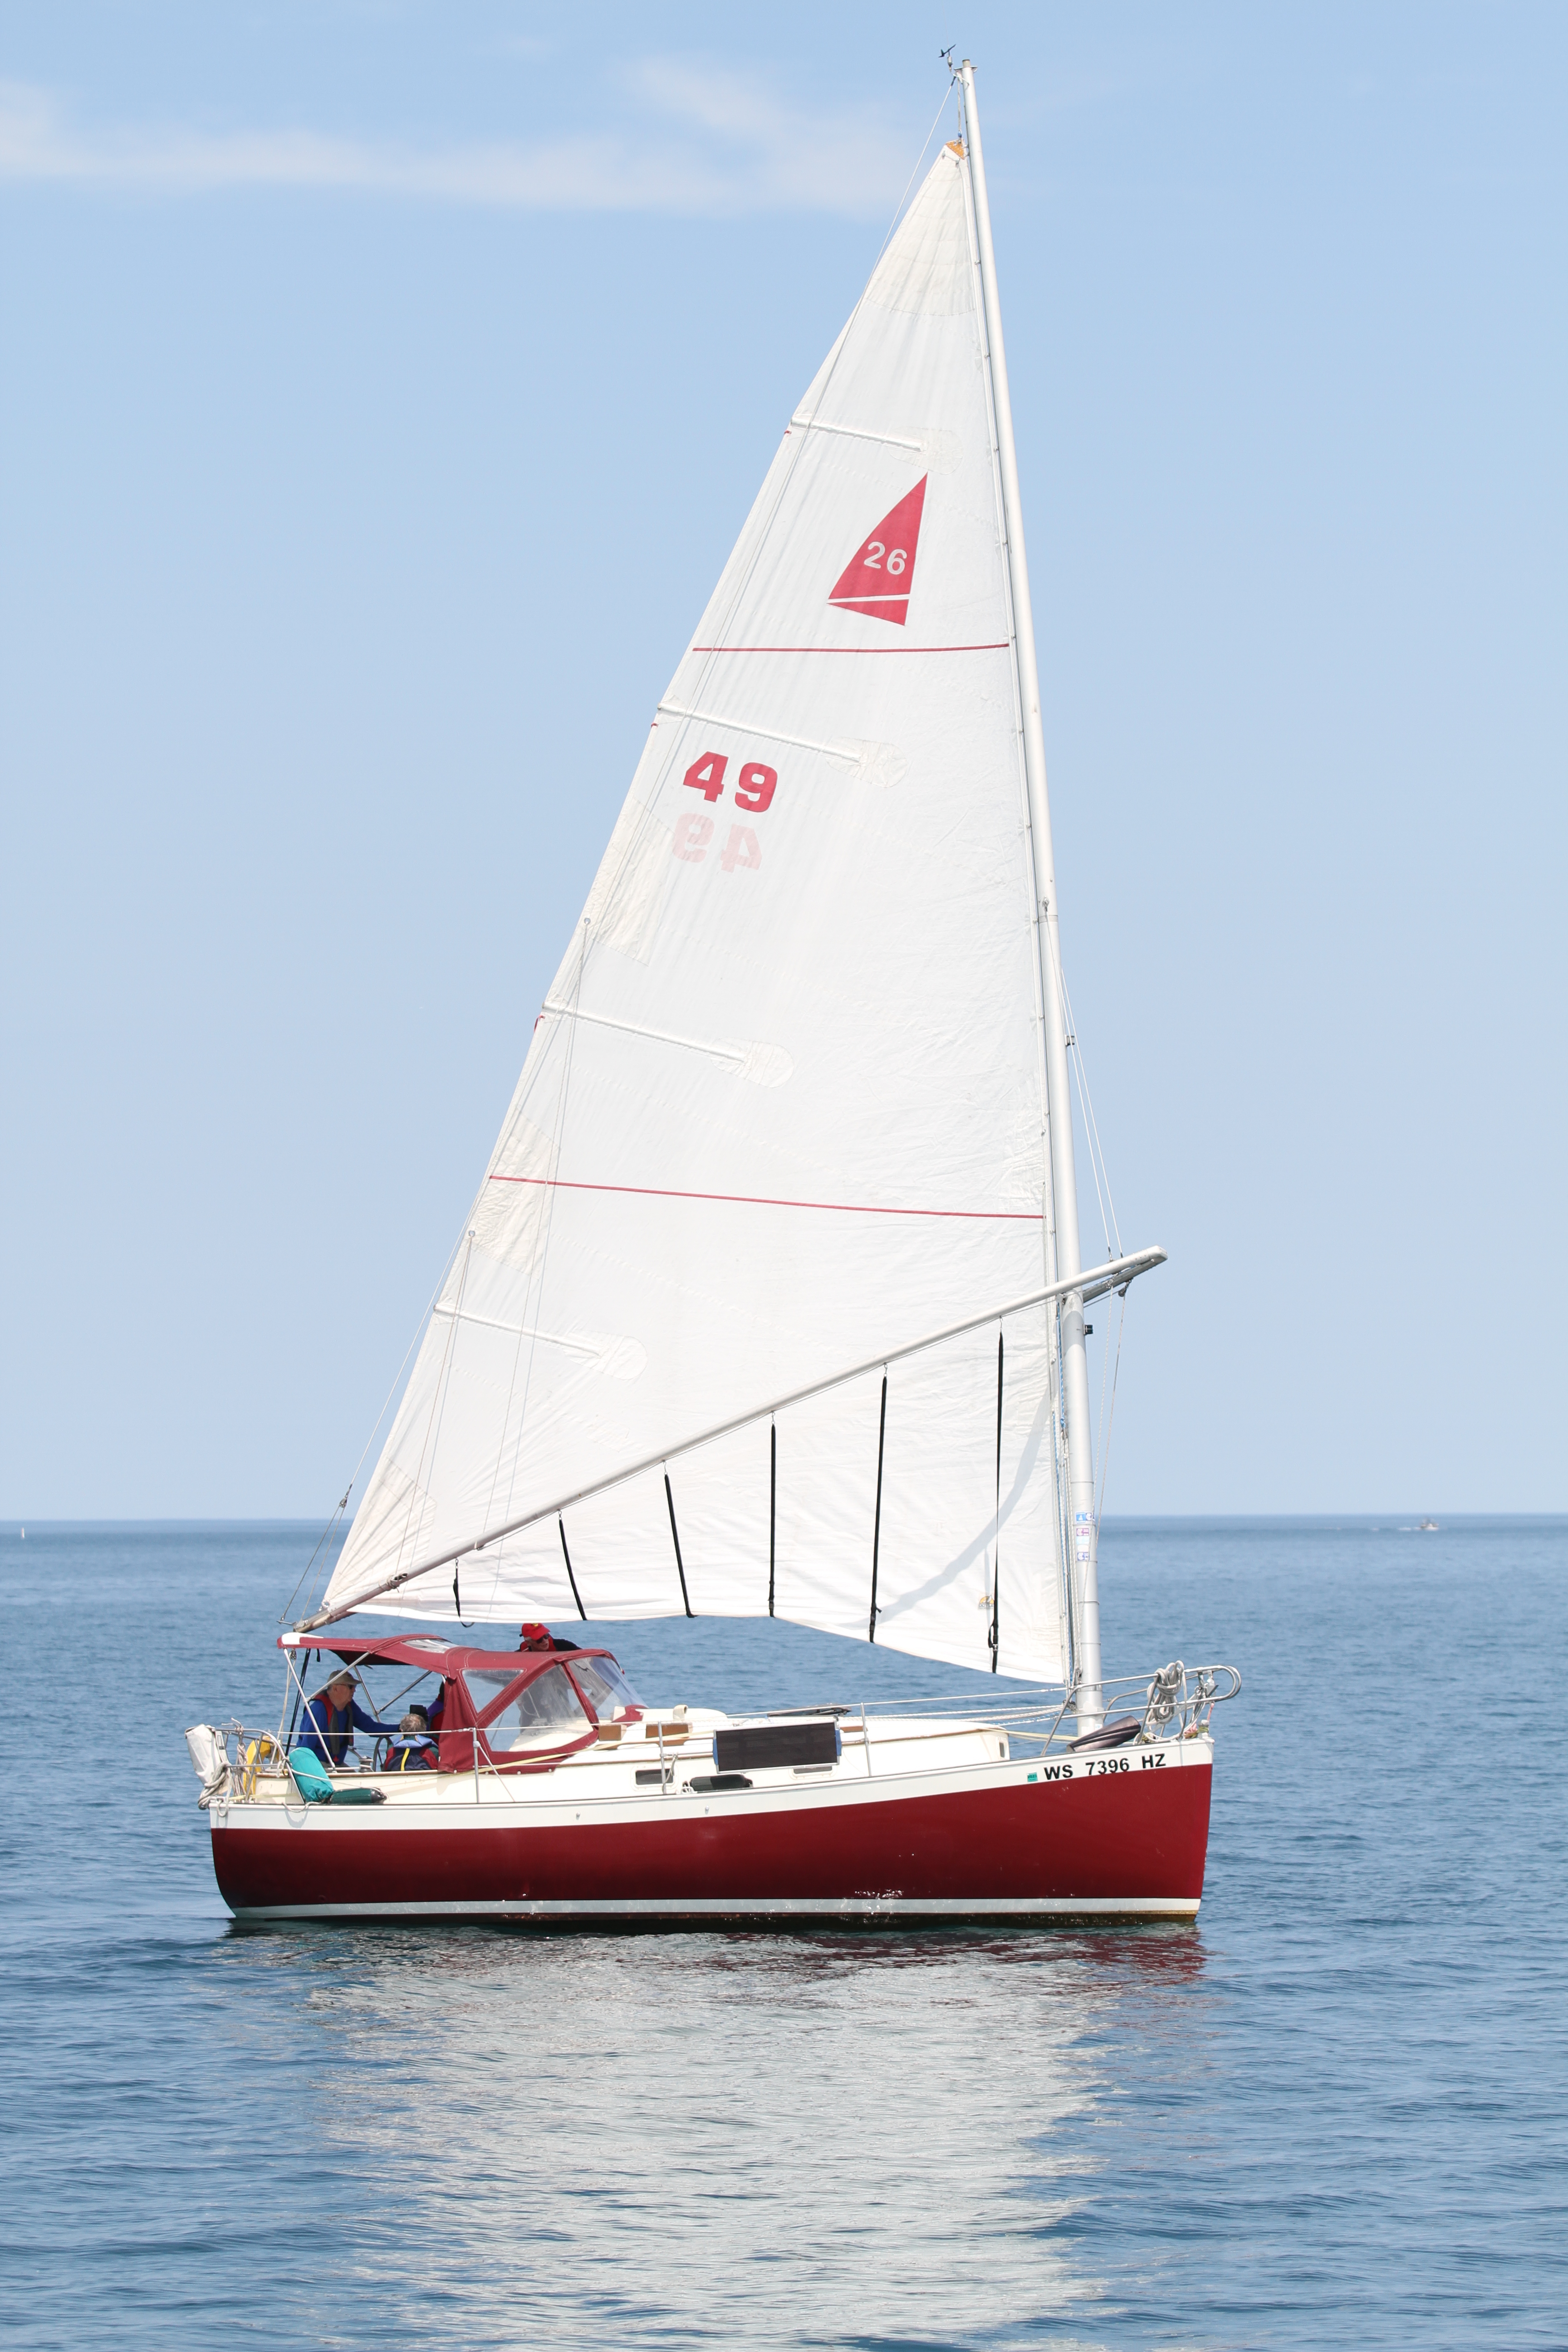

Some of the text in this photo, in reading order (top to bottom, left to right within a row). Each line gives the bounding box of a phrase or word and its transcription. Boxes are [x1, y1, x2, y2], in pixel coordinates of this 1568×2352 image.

[864, 541, 907, 575] 26
[683, 751, 778, 812] 49
[1044, 1754, 1166, 1780] WS 7396 HZ
